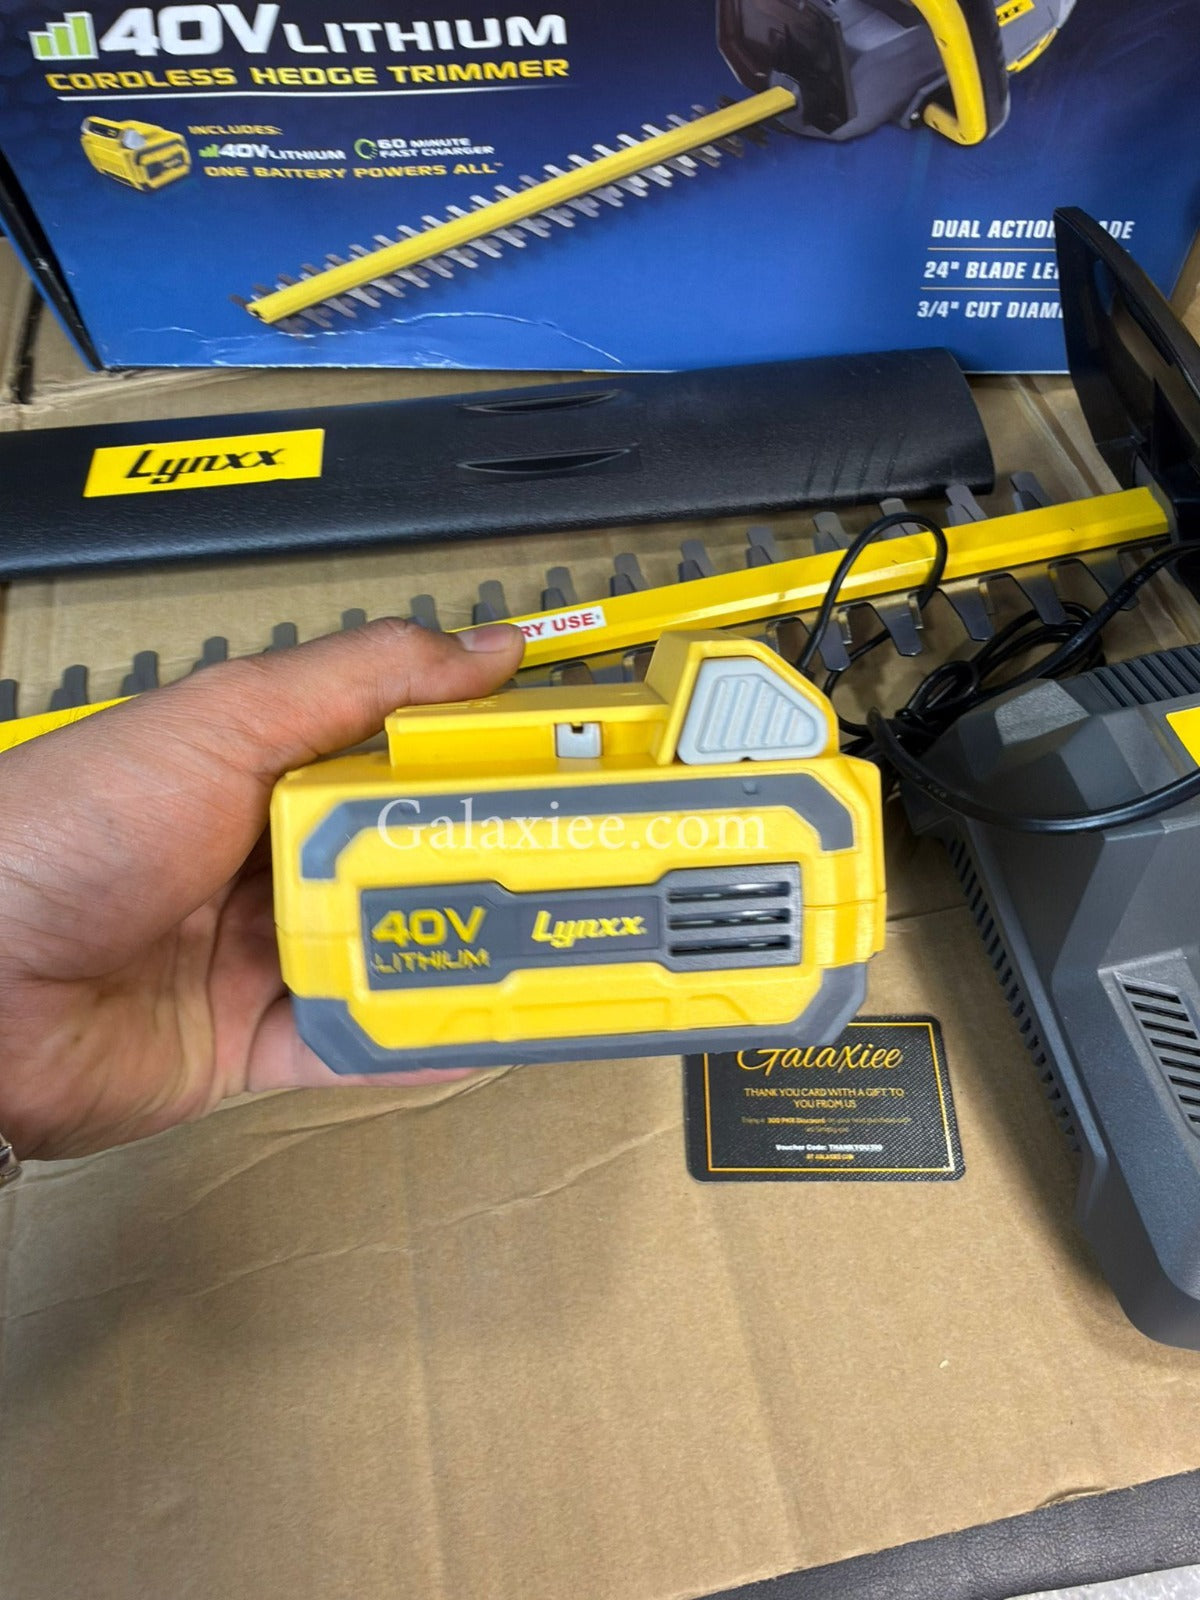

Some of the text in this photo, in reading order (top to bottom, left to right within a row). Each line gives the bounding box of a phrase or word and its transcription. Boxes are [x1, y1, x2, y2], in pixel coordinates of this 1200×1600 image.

[99, 3, 567, 56] 40V LITHIUM
[45, 58, 569, 90] CORDLESS HEDGE TRIMMER
[187, 124, 284, 136] INCLUDES:
[218, 143, 347, 161] 40V LITHIUM
[376, 138, 471, 149] 60 MINUTE
[379, 146, 496, 158] FAST CHARGER
[203, 166, 250, 177] ONE
[252, 166, 347, 179] BATTERY
[352, 165, 447, 178] POWERS
[931, 219, 981, 239] DUAL
[923, 261, 960, 279] 24"
[965, 261, 1027, 280] BLADE
[916, 300, 1064, 319] 3/4" CUT DIAM
[125, 449, 285, 485] Lynxx
[551, 612, 595, 632] USE
[370, 905, 648, 948] 40V Lynxx
[371, 947, 492, 974] LITHIUM
[743, 1087, 777, 1097] THANK
[778, 1087, 800, 1097] YOU
[801, 1087, 827, 1097] CARD
[828, 1087, 856, 1097] WITH
[857, 1087, 866, 1097] A
[890, 1087, 905, 1097] TO
[793, 1099, 857, 1109] YOU FROM US
